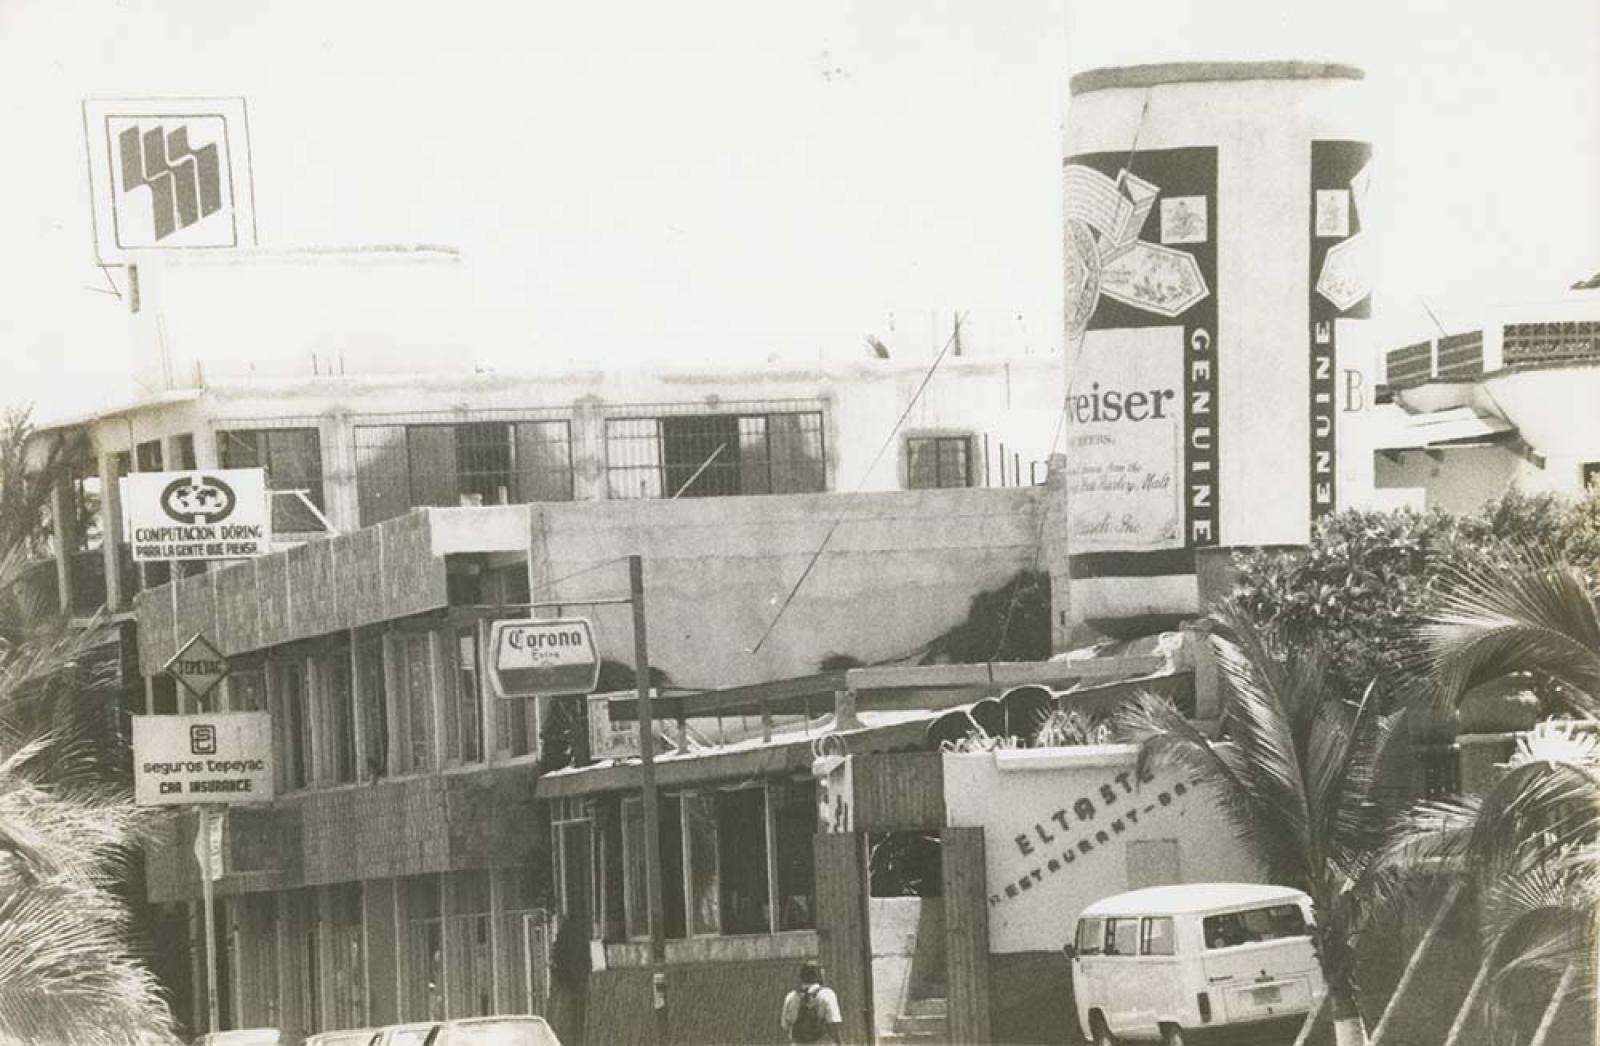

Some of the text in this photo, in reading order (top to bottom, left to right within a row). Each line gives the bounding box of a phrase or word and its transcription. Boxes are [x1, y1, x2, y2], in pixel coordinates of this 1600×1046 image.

[1315, 320, 1331, 505] ENUINE
[1191, 327, 1212, 542] GENUINE
[508, 628, 582, 651] Corona
[143, 758, 265, 775] seguros tepeyac
[159, 778, 252, 794] CAR INSURANCE
